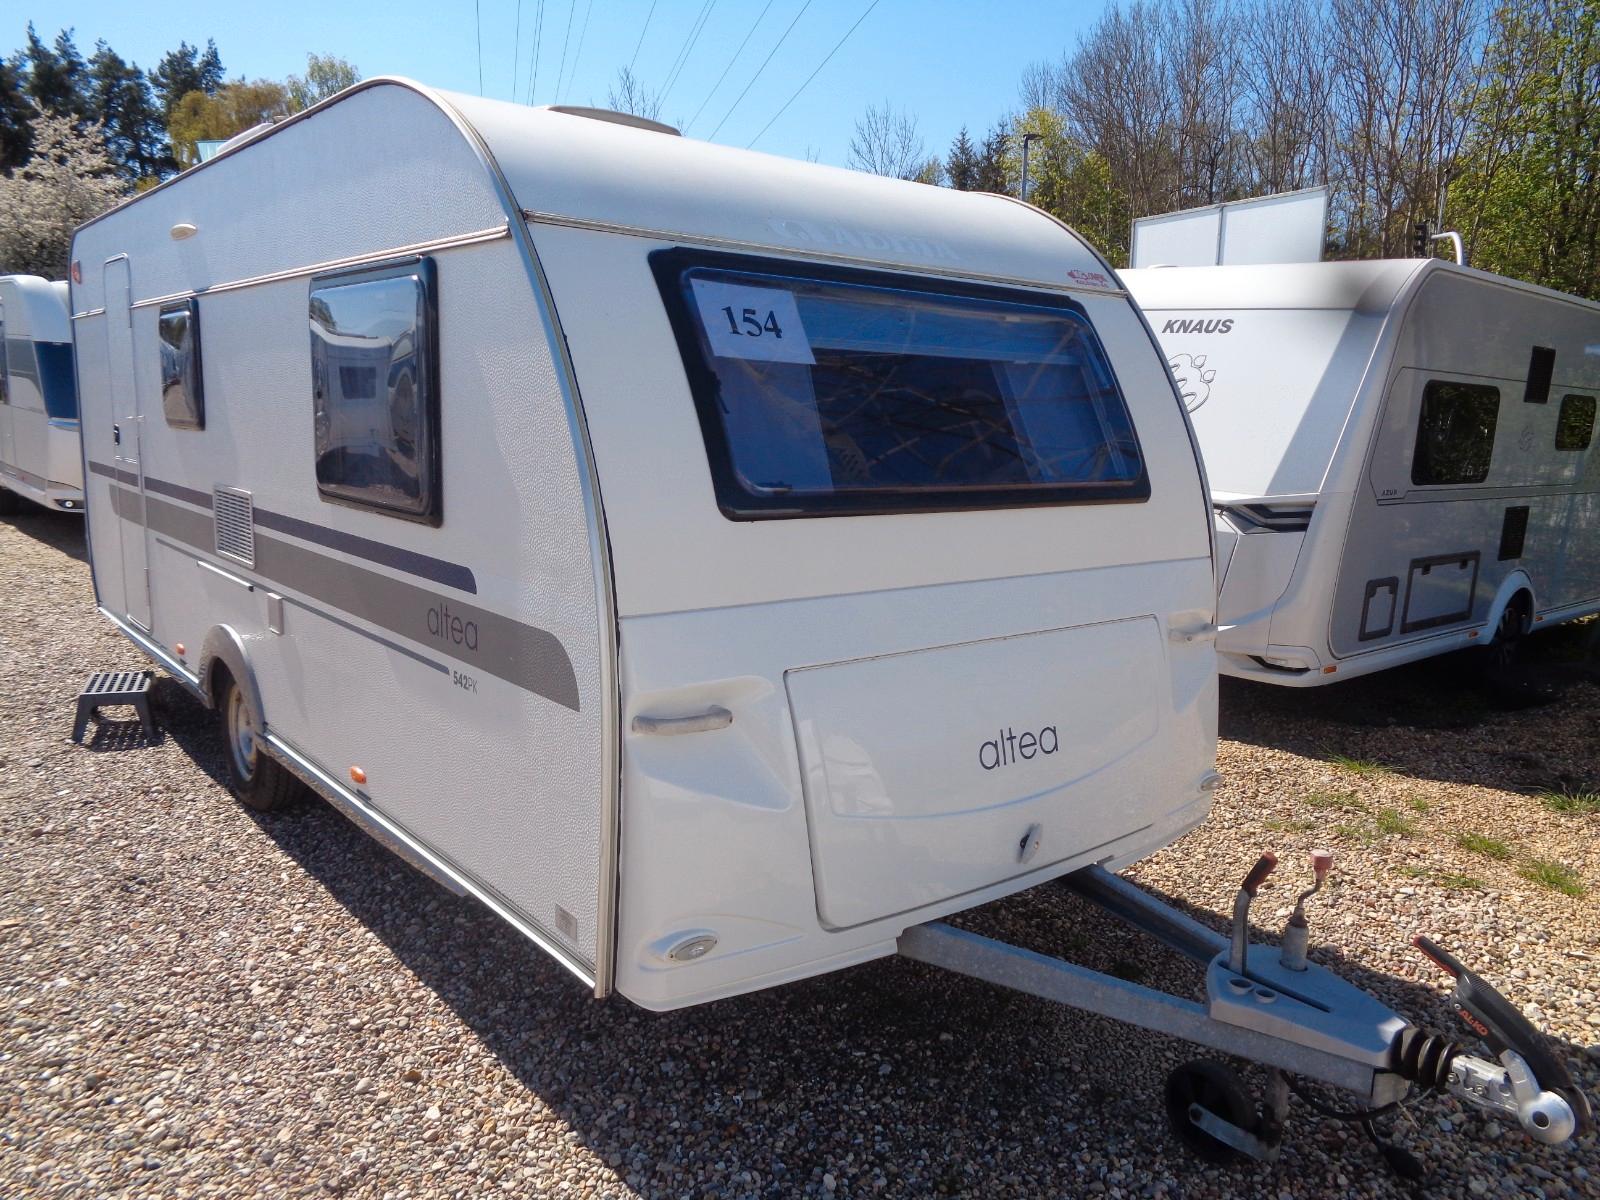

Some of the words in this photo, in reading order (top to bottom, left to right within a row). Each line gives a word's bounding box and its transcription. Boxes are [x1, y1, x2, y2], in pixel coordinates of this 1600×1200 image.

[721, 305, 783, 339] 154
[1161, 318, 1235, 334] KNAUS
[427, 602, 478, 652] altea
[979, 725, 1059, 770] altea
